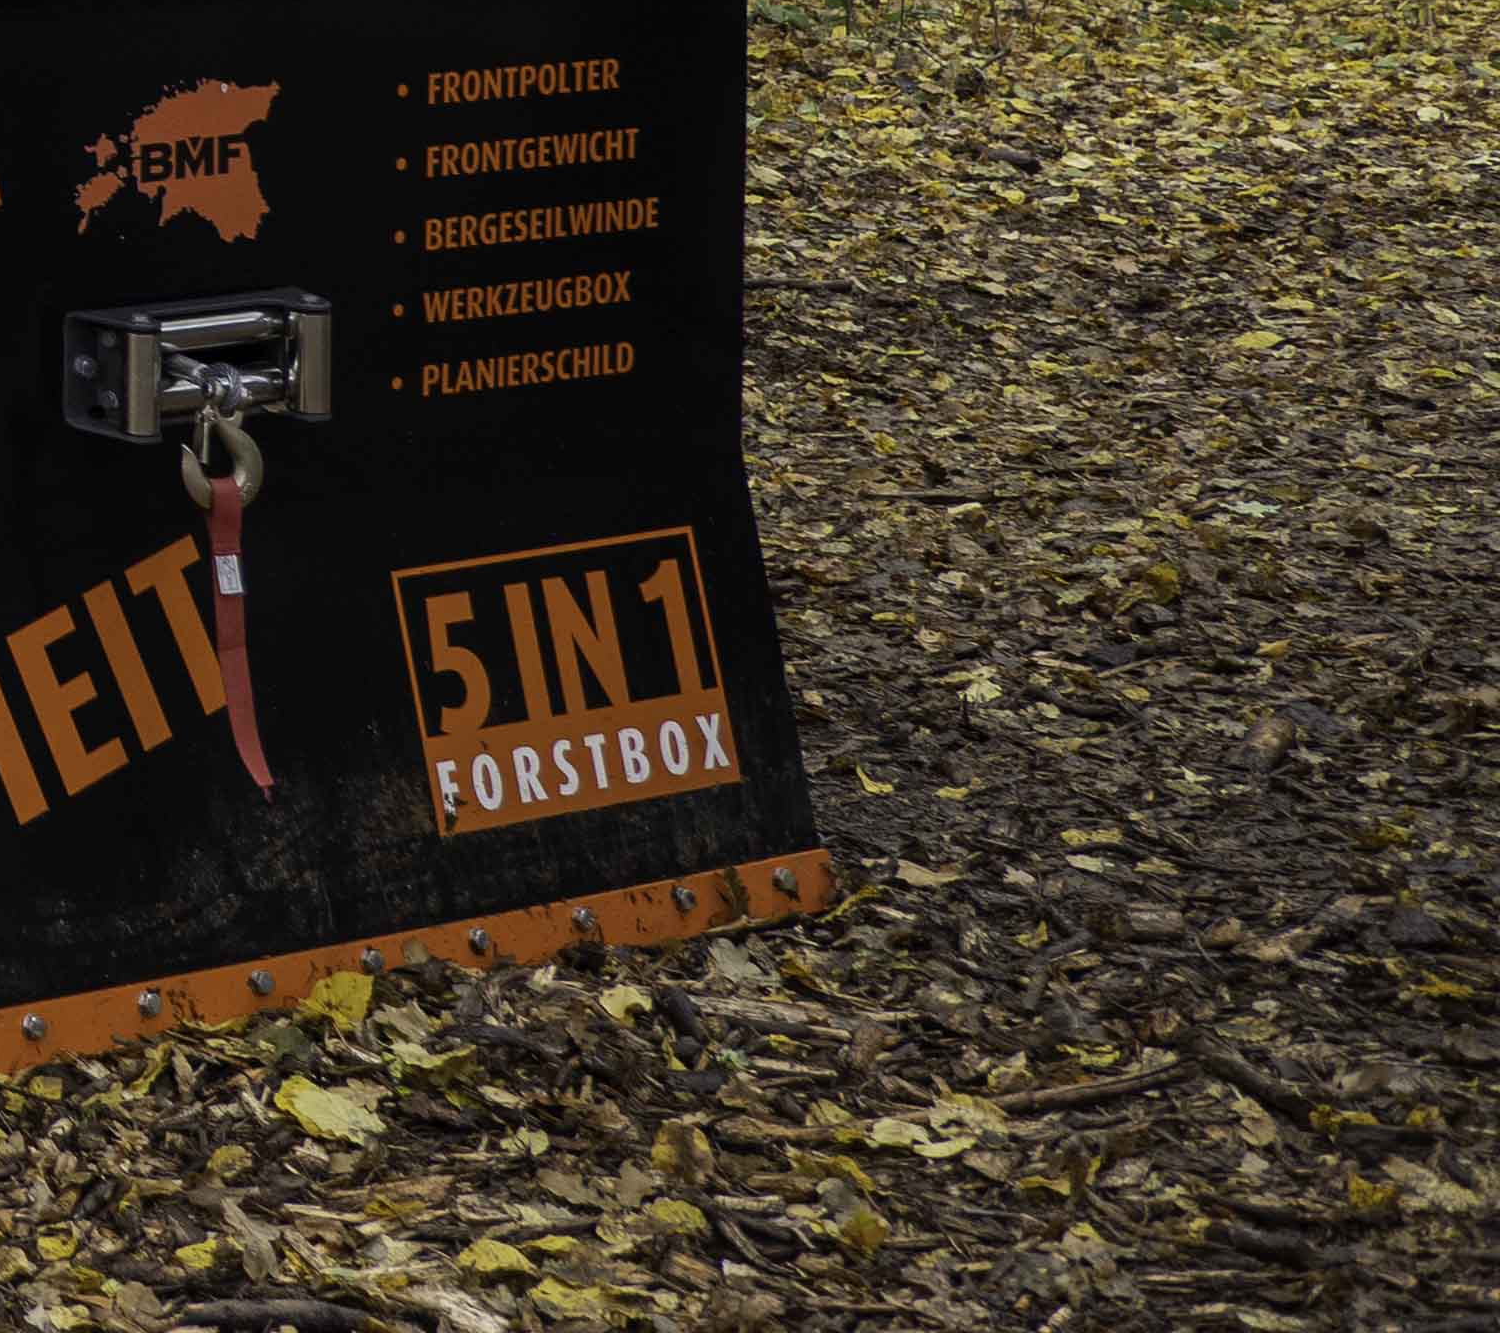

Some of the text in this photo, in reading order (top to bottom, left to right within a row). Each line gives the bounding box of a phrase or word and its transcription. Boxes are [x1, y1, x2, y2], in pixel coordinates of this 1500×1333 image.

[427, 58, 621, 105] FRONTPOLTER
[138, 134, 247, 183] BMF
[425, 128, 641, 179] FRONTGEWICHT
[424, 196, 660, 252] BERGESEILWINDE
[422, 270, 632, 324] WERKZEUGBOX
[421, 341, 635, 397] PLANIERSCHILD
[424, 558, 704, 736] 5 IN 1
[435, 712, 731, 817] FORSTBOX
